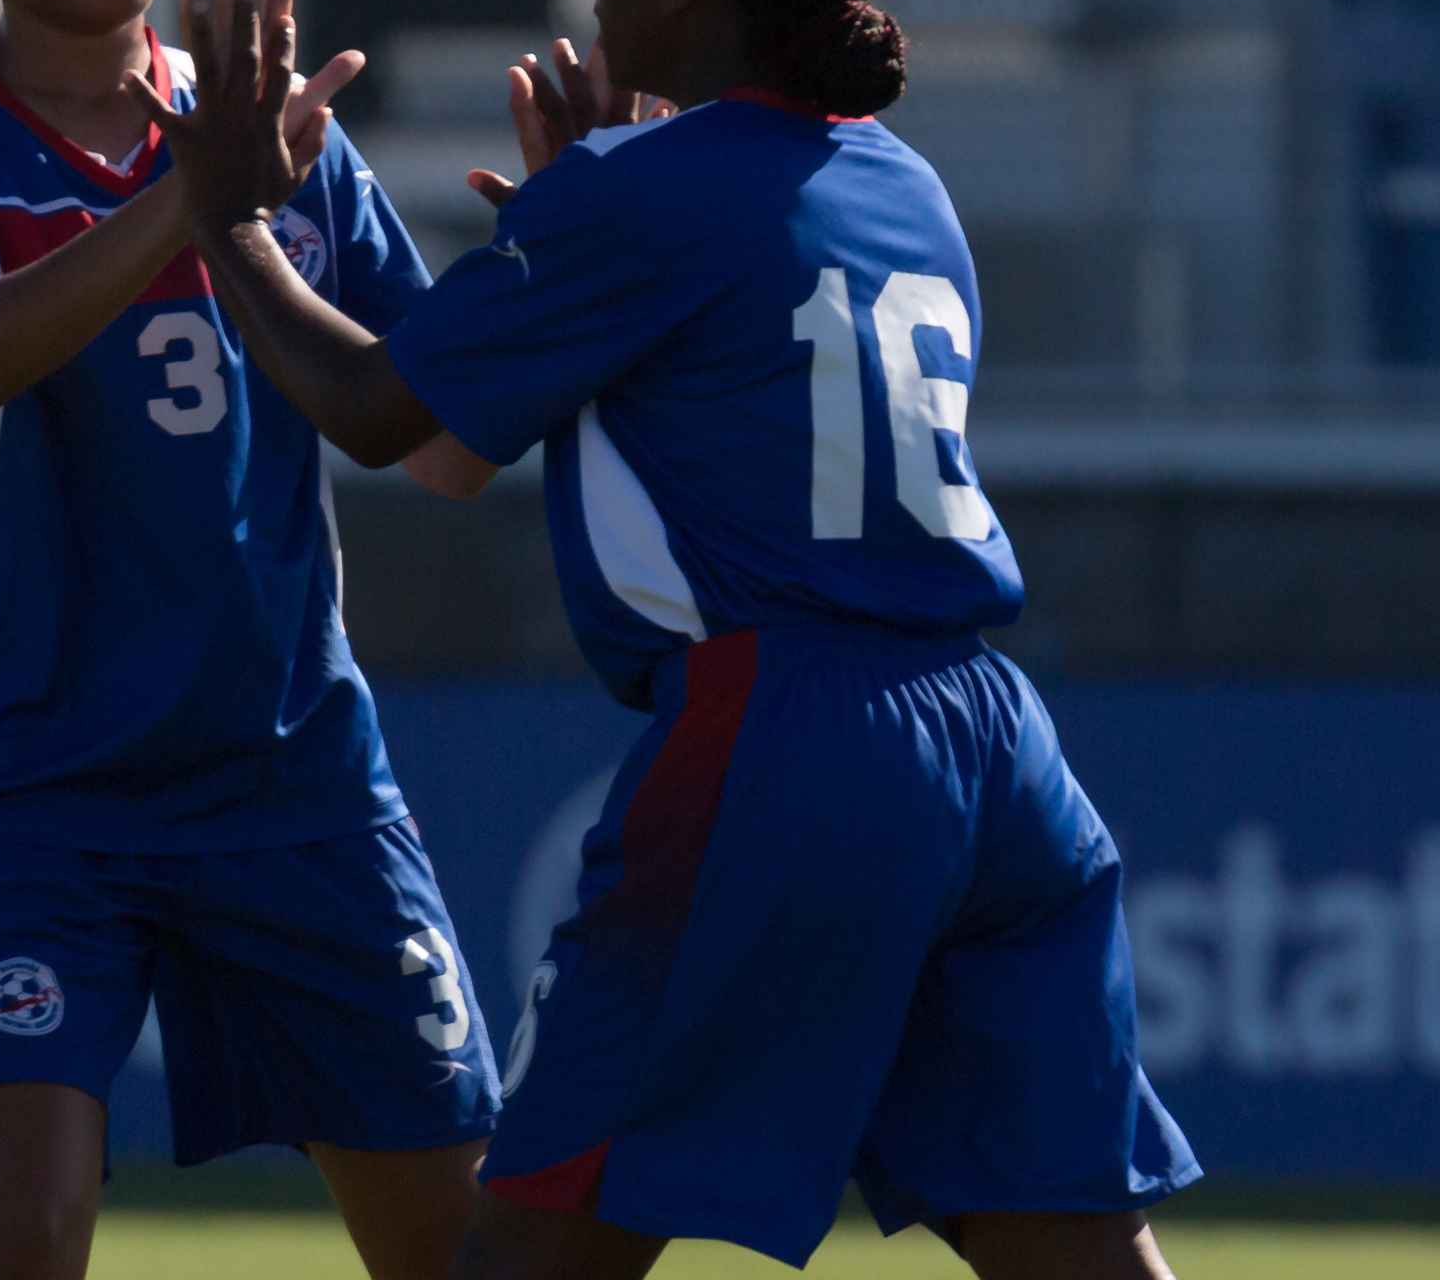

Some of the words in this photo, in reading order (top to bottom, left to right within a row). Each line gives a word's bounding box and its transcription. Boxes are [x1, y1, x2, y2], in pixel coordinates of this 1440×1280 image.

[137, 311, 228, 437] 3
[792, 266, 991, 541] 16
[399, 926, 471, 1053] 3
